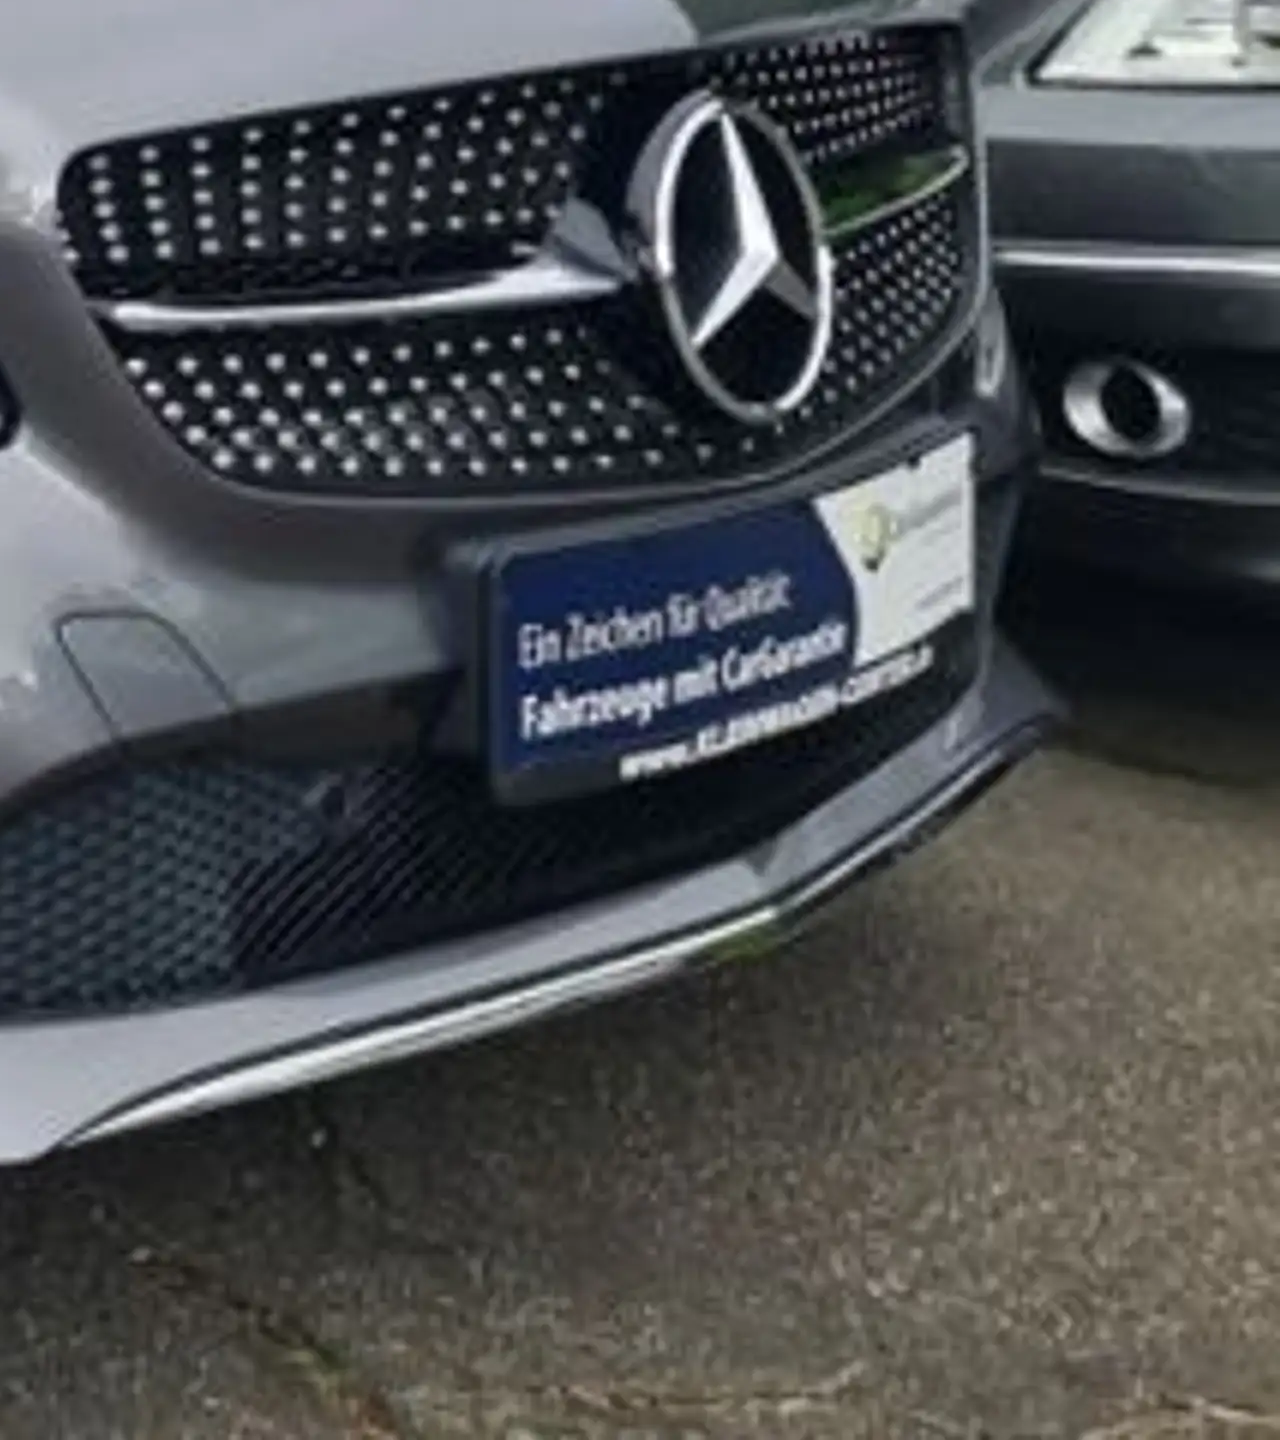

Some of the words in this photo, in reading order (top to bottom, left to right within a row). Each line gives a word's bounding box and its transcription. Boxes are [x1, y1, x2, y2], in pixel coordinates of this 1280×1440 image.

[517, 622, 562, 669] Ein
[521, 676, 668, 742] Fahrzeuge
[673, 656, 718, 704] mit
